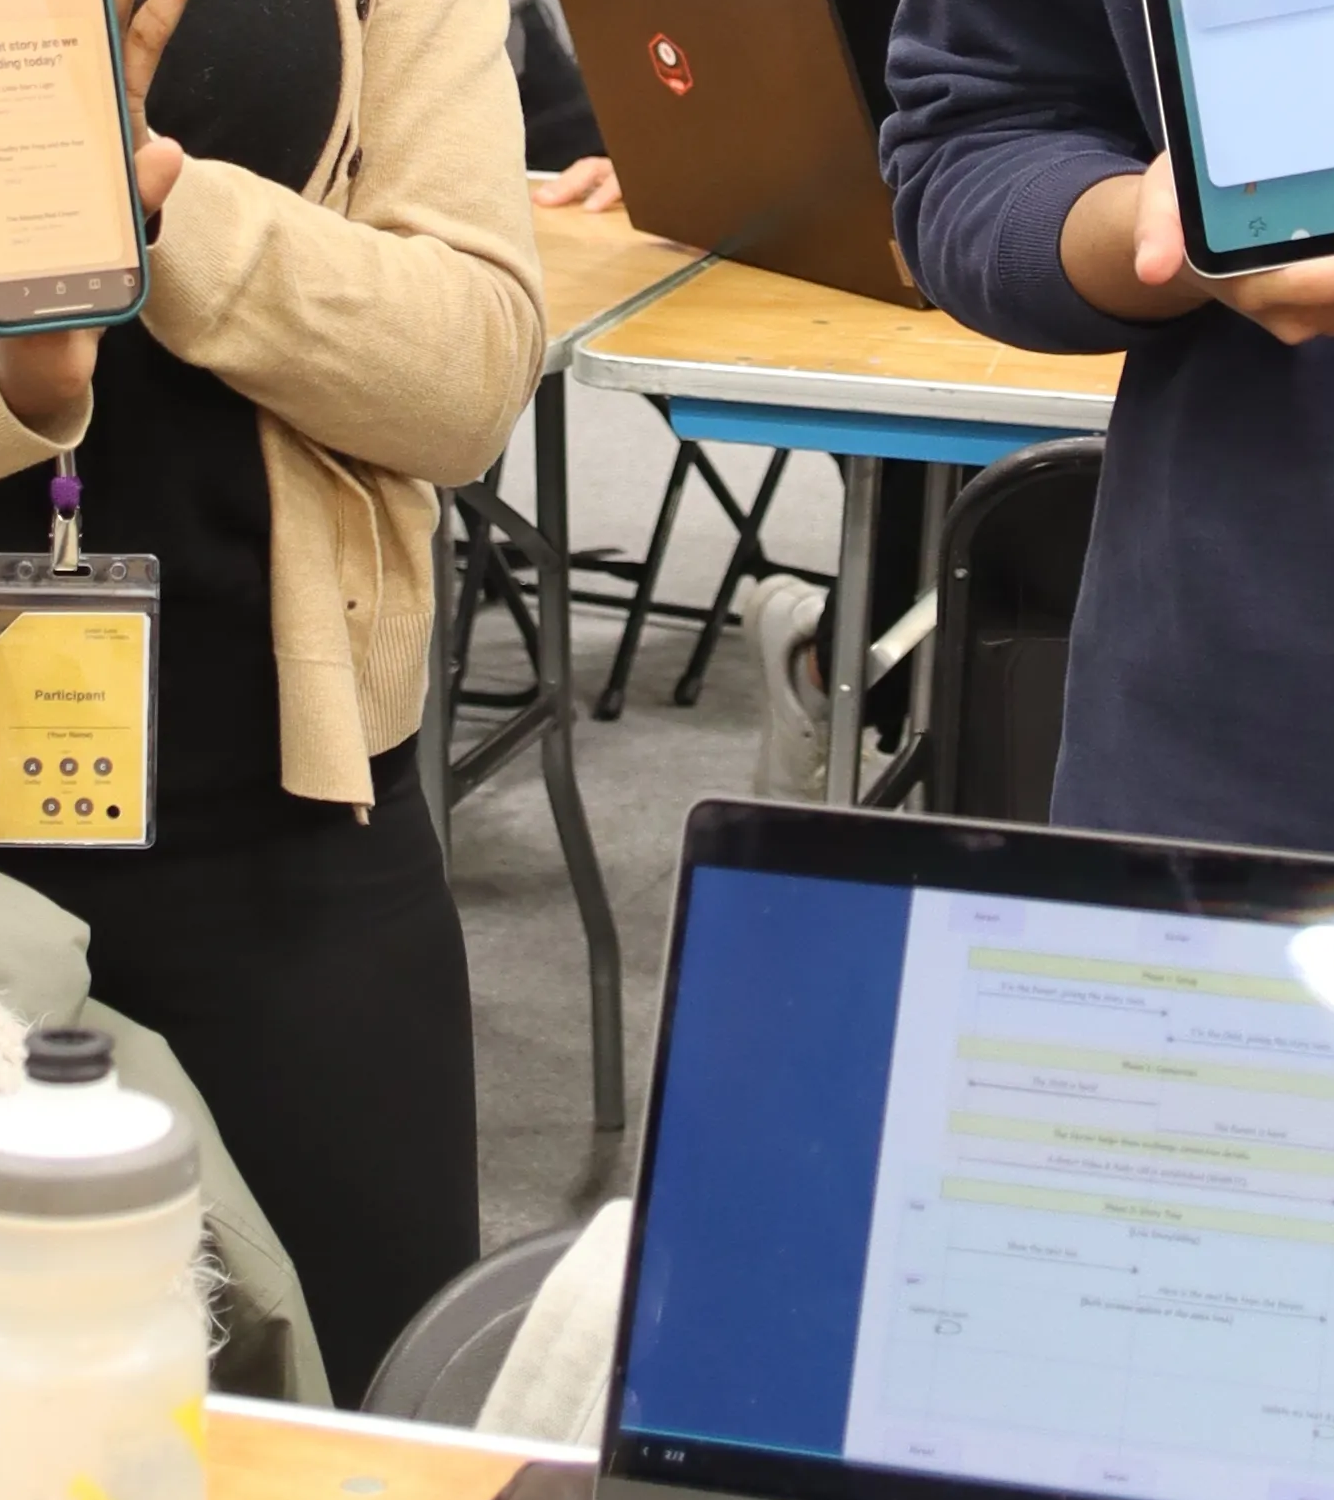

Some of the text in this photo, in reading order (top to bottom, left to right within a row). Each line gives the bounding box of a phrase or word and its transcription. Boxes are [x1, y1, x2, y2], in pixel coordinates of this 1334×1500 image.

[9, 41, 38, 55] story
[41, 39, 59, 49] are
[61, 37, 79, 47] we
[23, 54, 63, 70] today?
[34, 689, 106, 703] Participant
[29, 763, 37, 771] A
